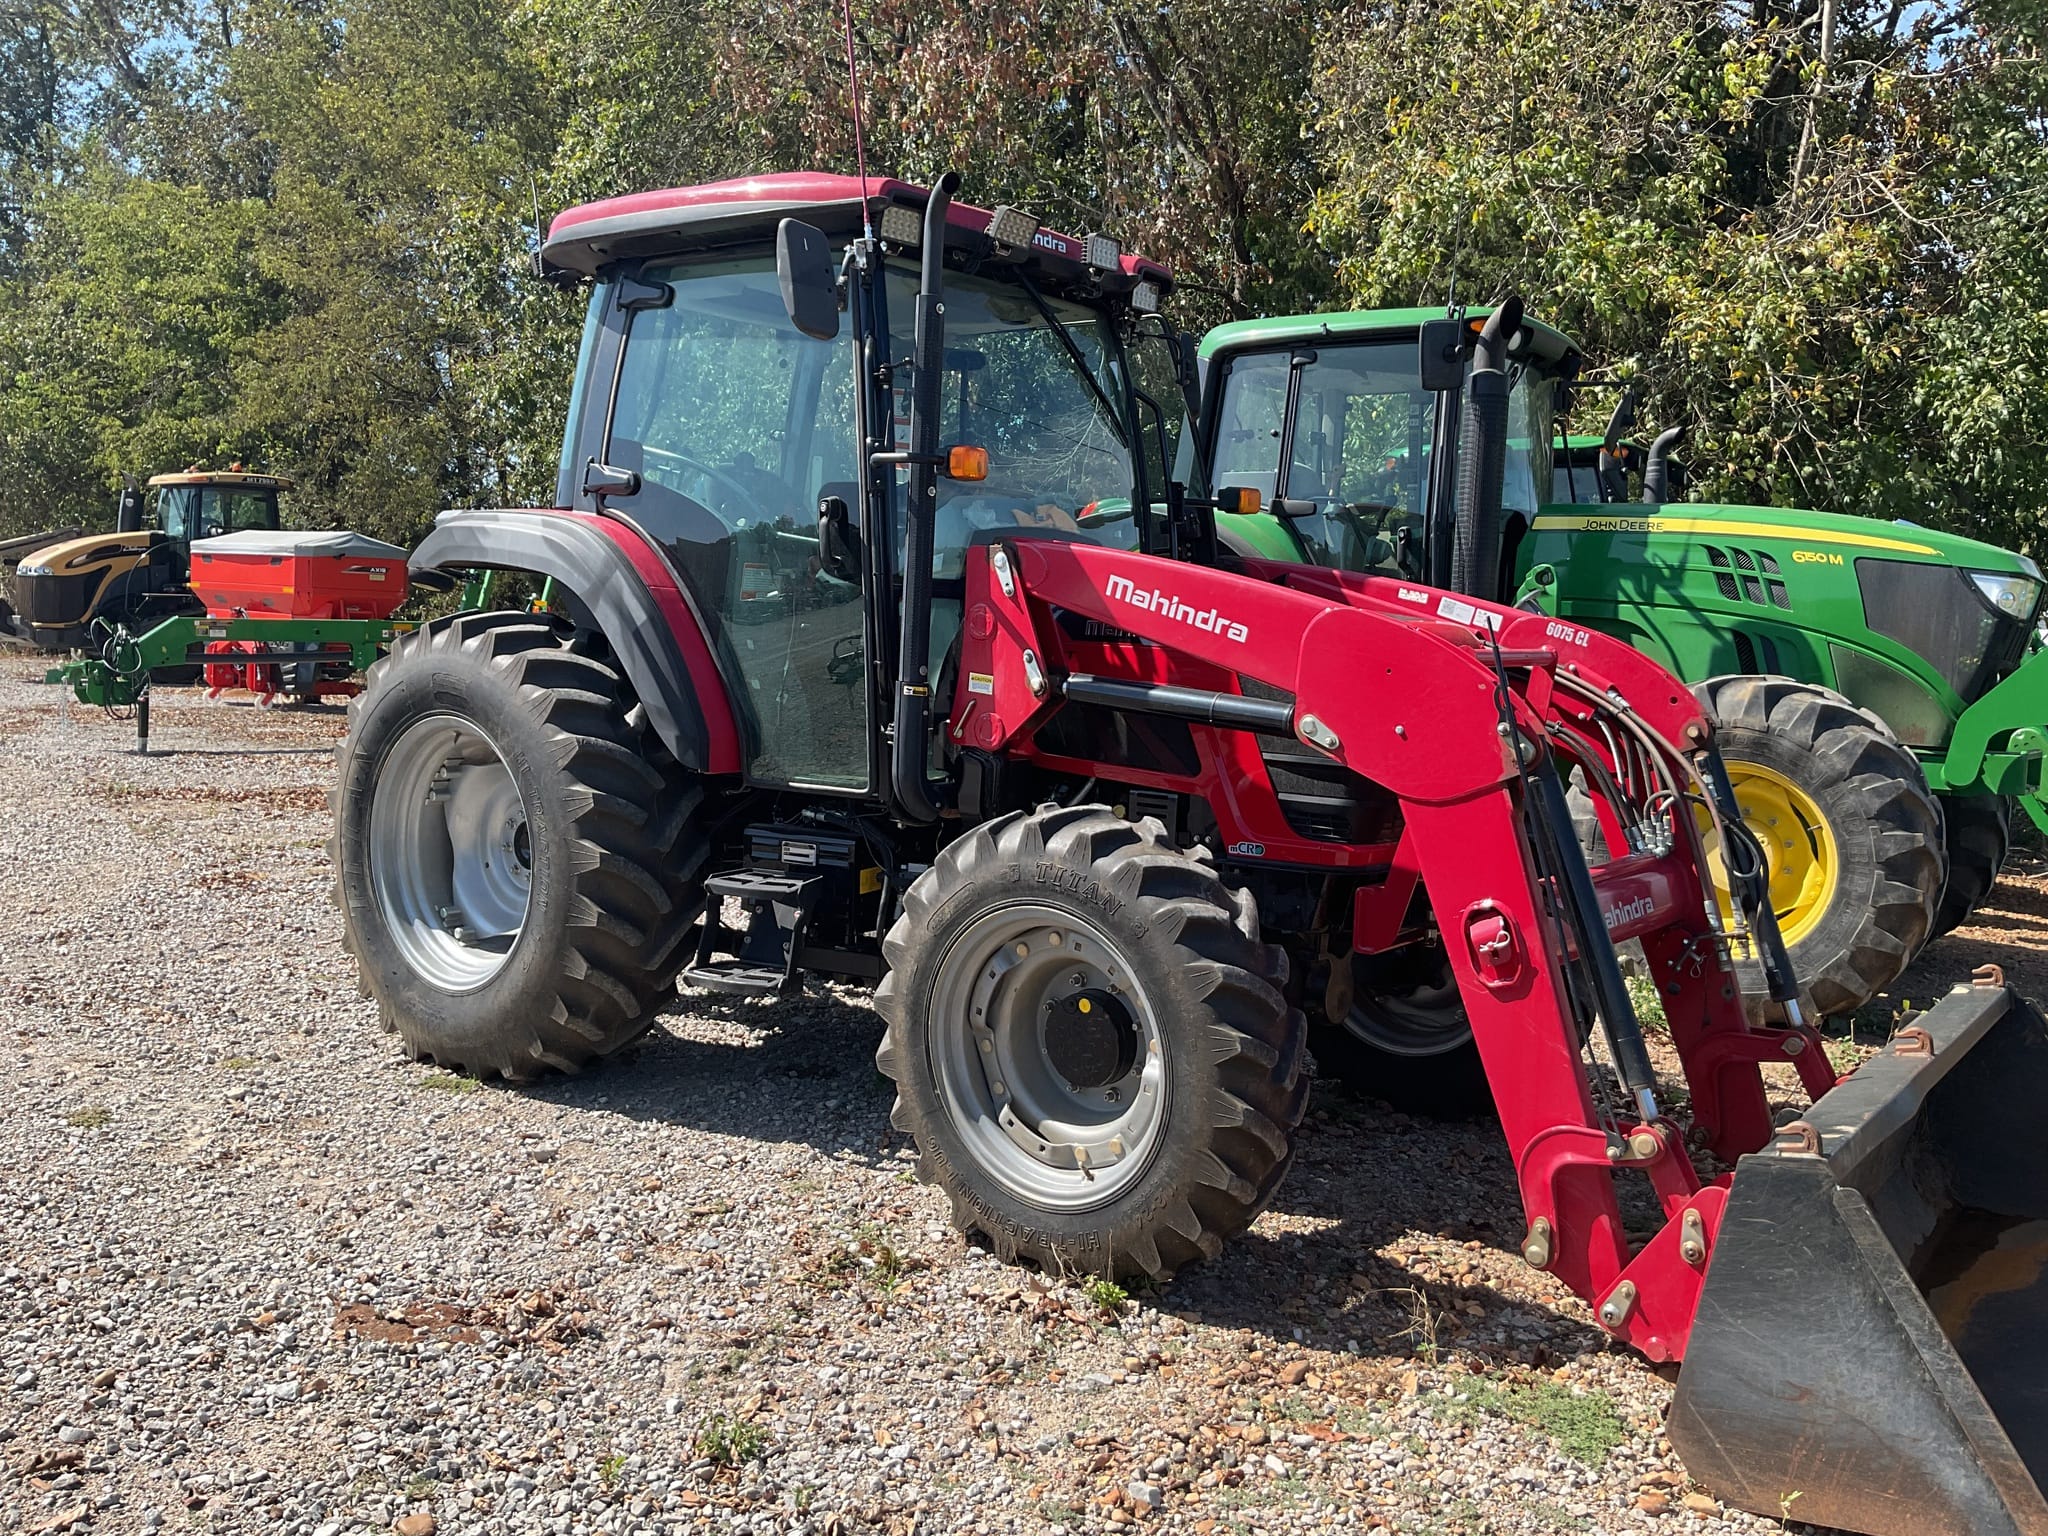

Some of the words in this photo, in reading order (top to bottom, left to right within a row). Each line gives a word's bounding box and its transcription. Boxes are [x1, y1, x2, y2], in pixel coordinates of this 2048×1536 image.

[1582, 518, 1617, 530] JOHN
[1619, 519, 1665, 531] DEERE
[1792, 551, 1827, 562] 6150
[1829, 553, 1843, 566] M
[1546, 621, 1575, 642] 6075
[1574, 630, 1590, 648] CL
[1035, 861, 1126, 916] TITAN
